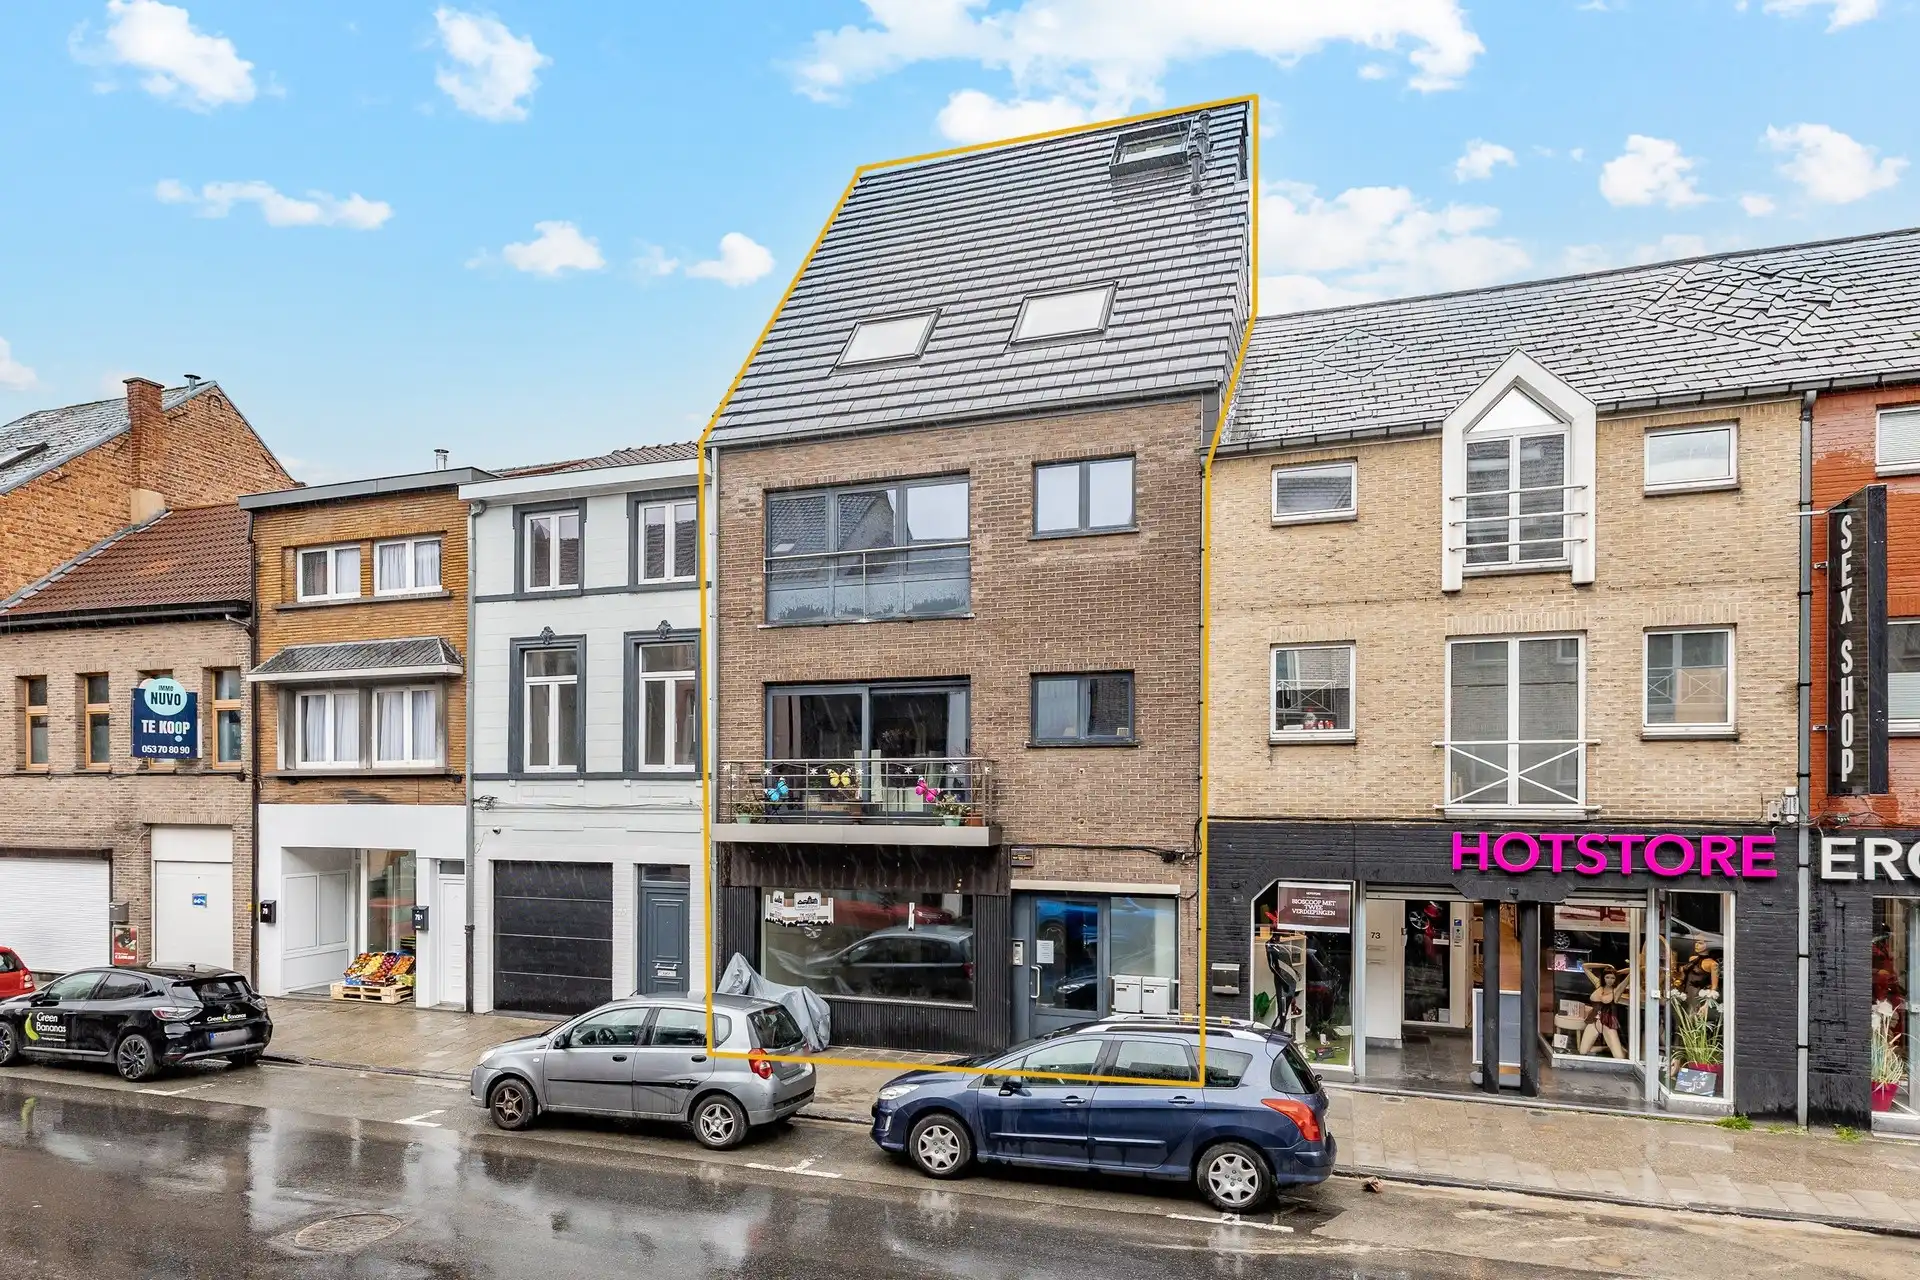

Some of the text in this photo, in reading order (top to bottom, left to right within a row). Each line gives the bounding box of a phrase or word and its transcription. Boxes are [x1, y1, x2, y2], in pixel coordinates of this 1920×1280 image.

[1840, 514, 1854, 782] SEX SHOP
[150, 692, 181, 706] NUVO
[141, 719, 191, 735] TE KOOP
[141, 745, 190, 754] 053 70 80 90
[1452, 831, 1777, 878] HOTSTORE
[1821, 837, 1920, 881] ER
[1291, 898, 1322, 906] BIOSCOOP
[1291, 908, 1336, 916] VERDIEPINGEN
[1370, 931, 1381, 939] 73
[36, 1012, 58, 1022] Green
[36, 1021, 67, 1033] Bananas
